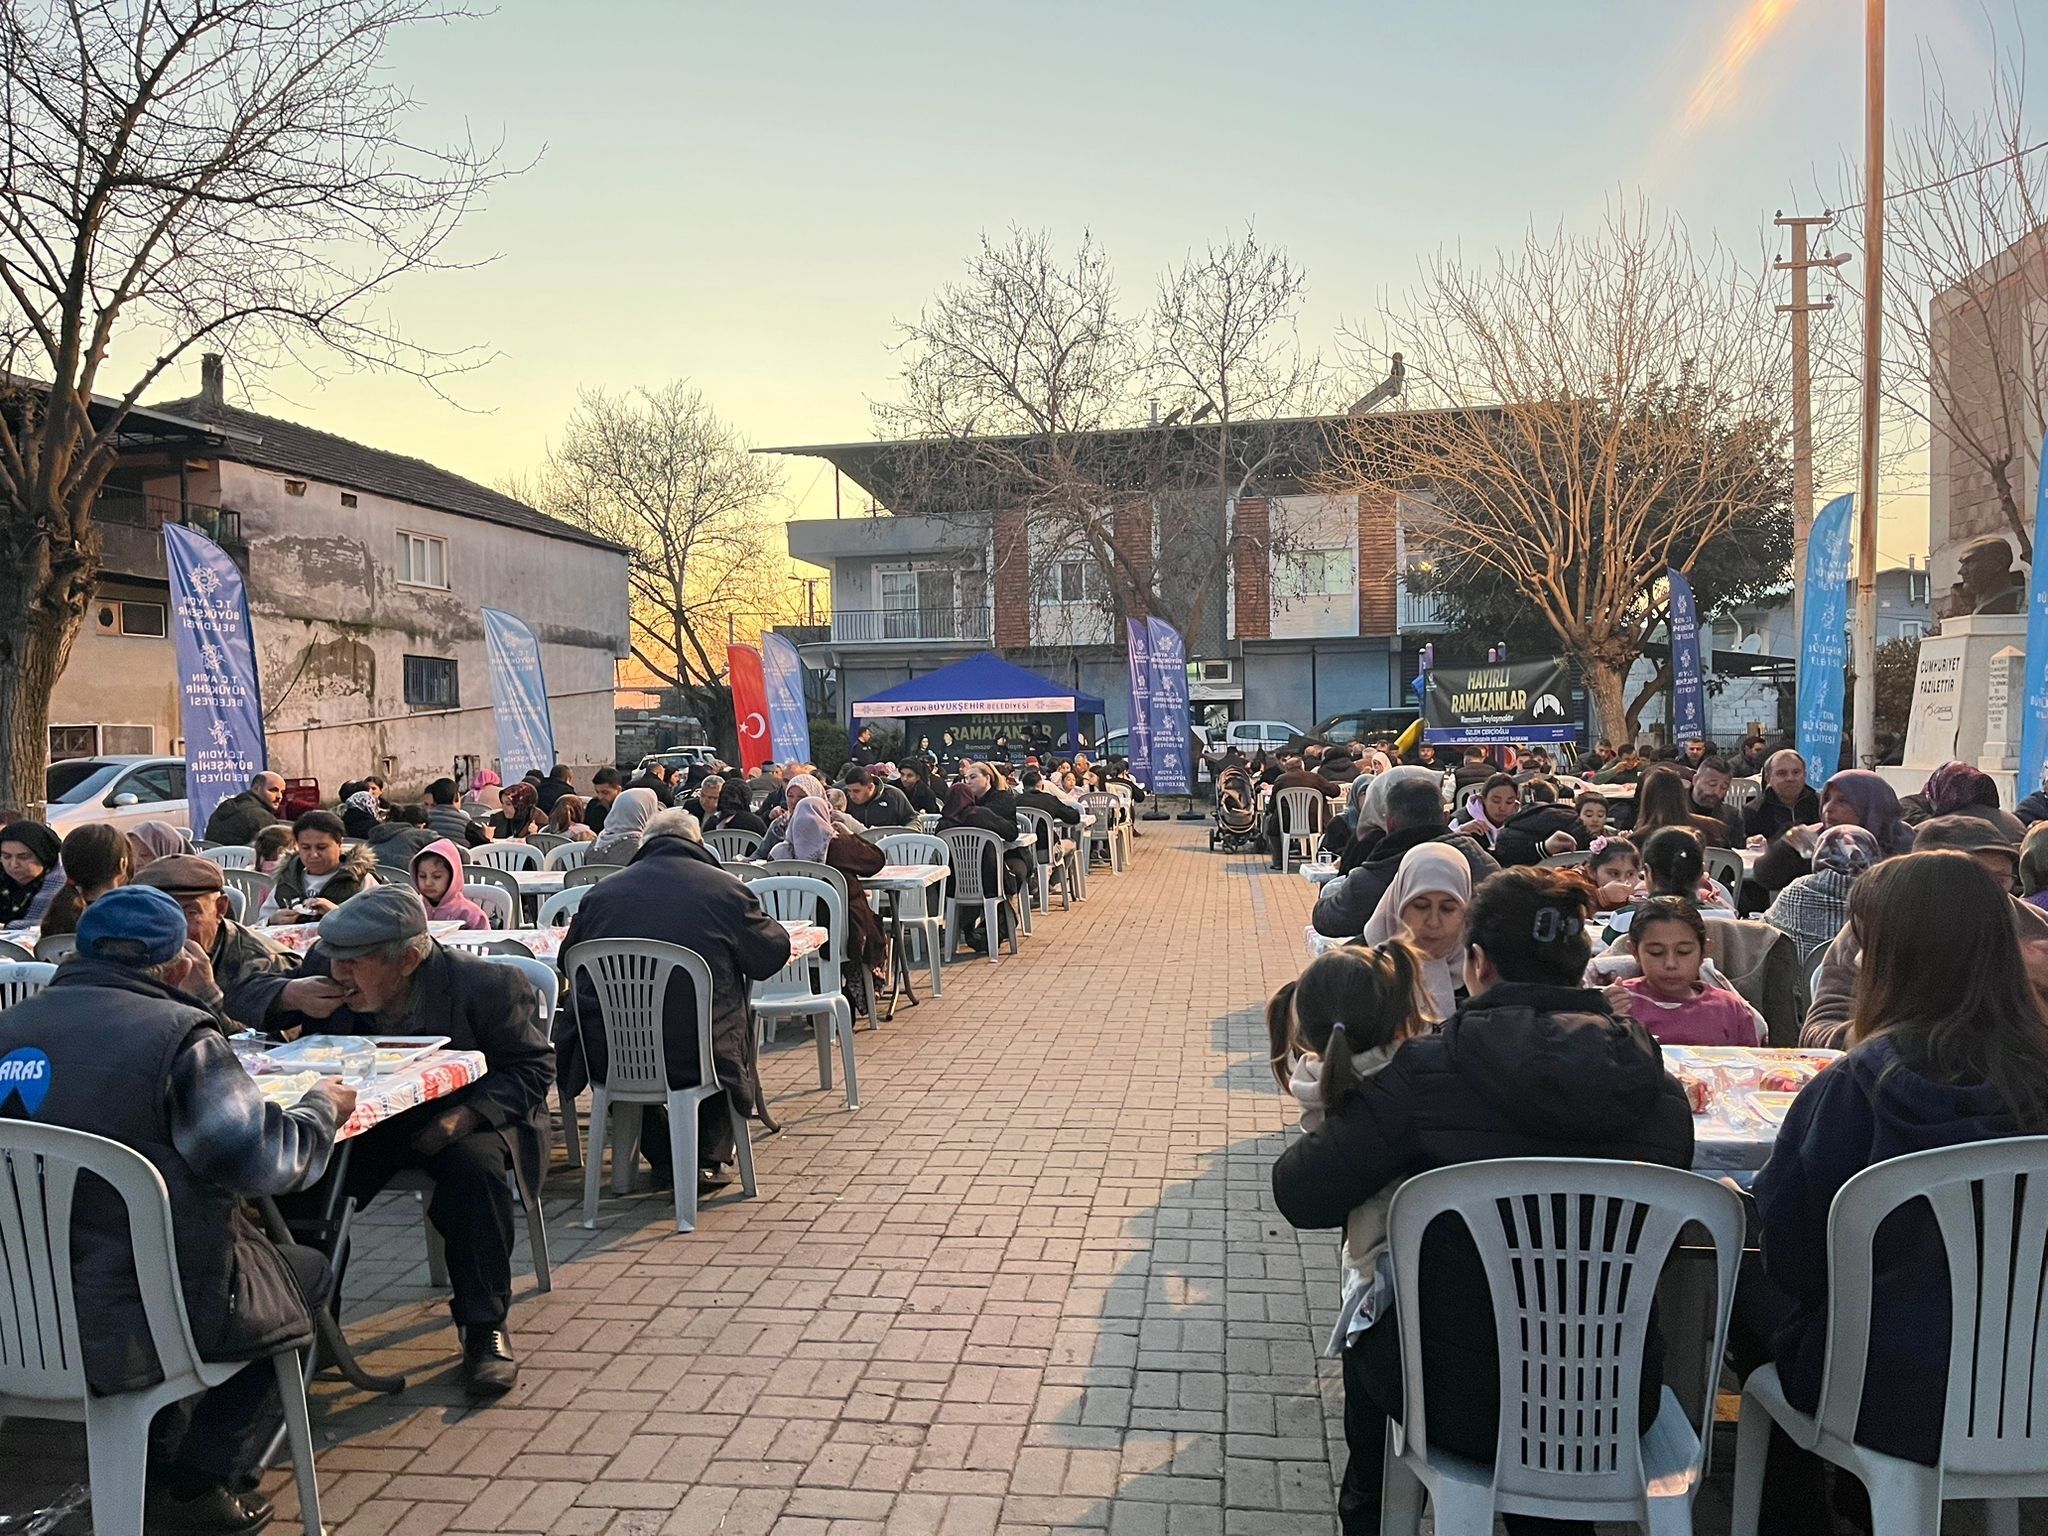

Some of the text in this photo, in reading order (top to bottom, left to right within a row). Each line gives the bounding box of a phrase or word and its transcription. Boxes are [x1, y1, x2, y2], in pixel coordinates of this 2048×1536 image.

[1921, 657, 1960, 673] CUMHURİYET
[1467, 668, 1511, 690] HAYIRLI
[1920, 676, 1954, 694] FAZİLETTİR
[904, 704, 927, 713] AYDIN
[928, 701, 985, 712] BÜYÜKŞEHİR
[986, 702, 1029, 710] BELEDİYESİ
[1451, 690, 1527, 713] RAMAZANLAR
[952, 724, 1052, 741] RAMAZANR
[0, 1059, 46, 1081] ARAS
